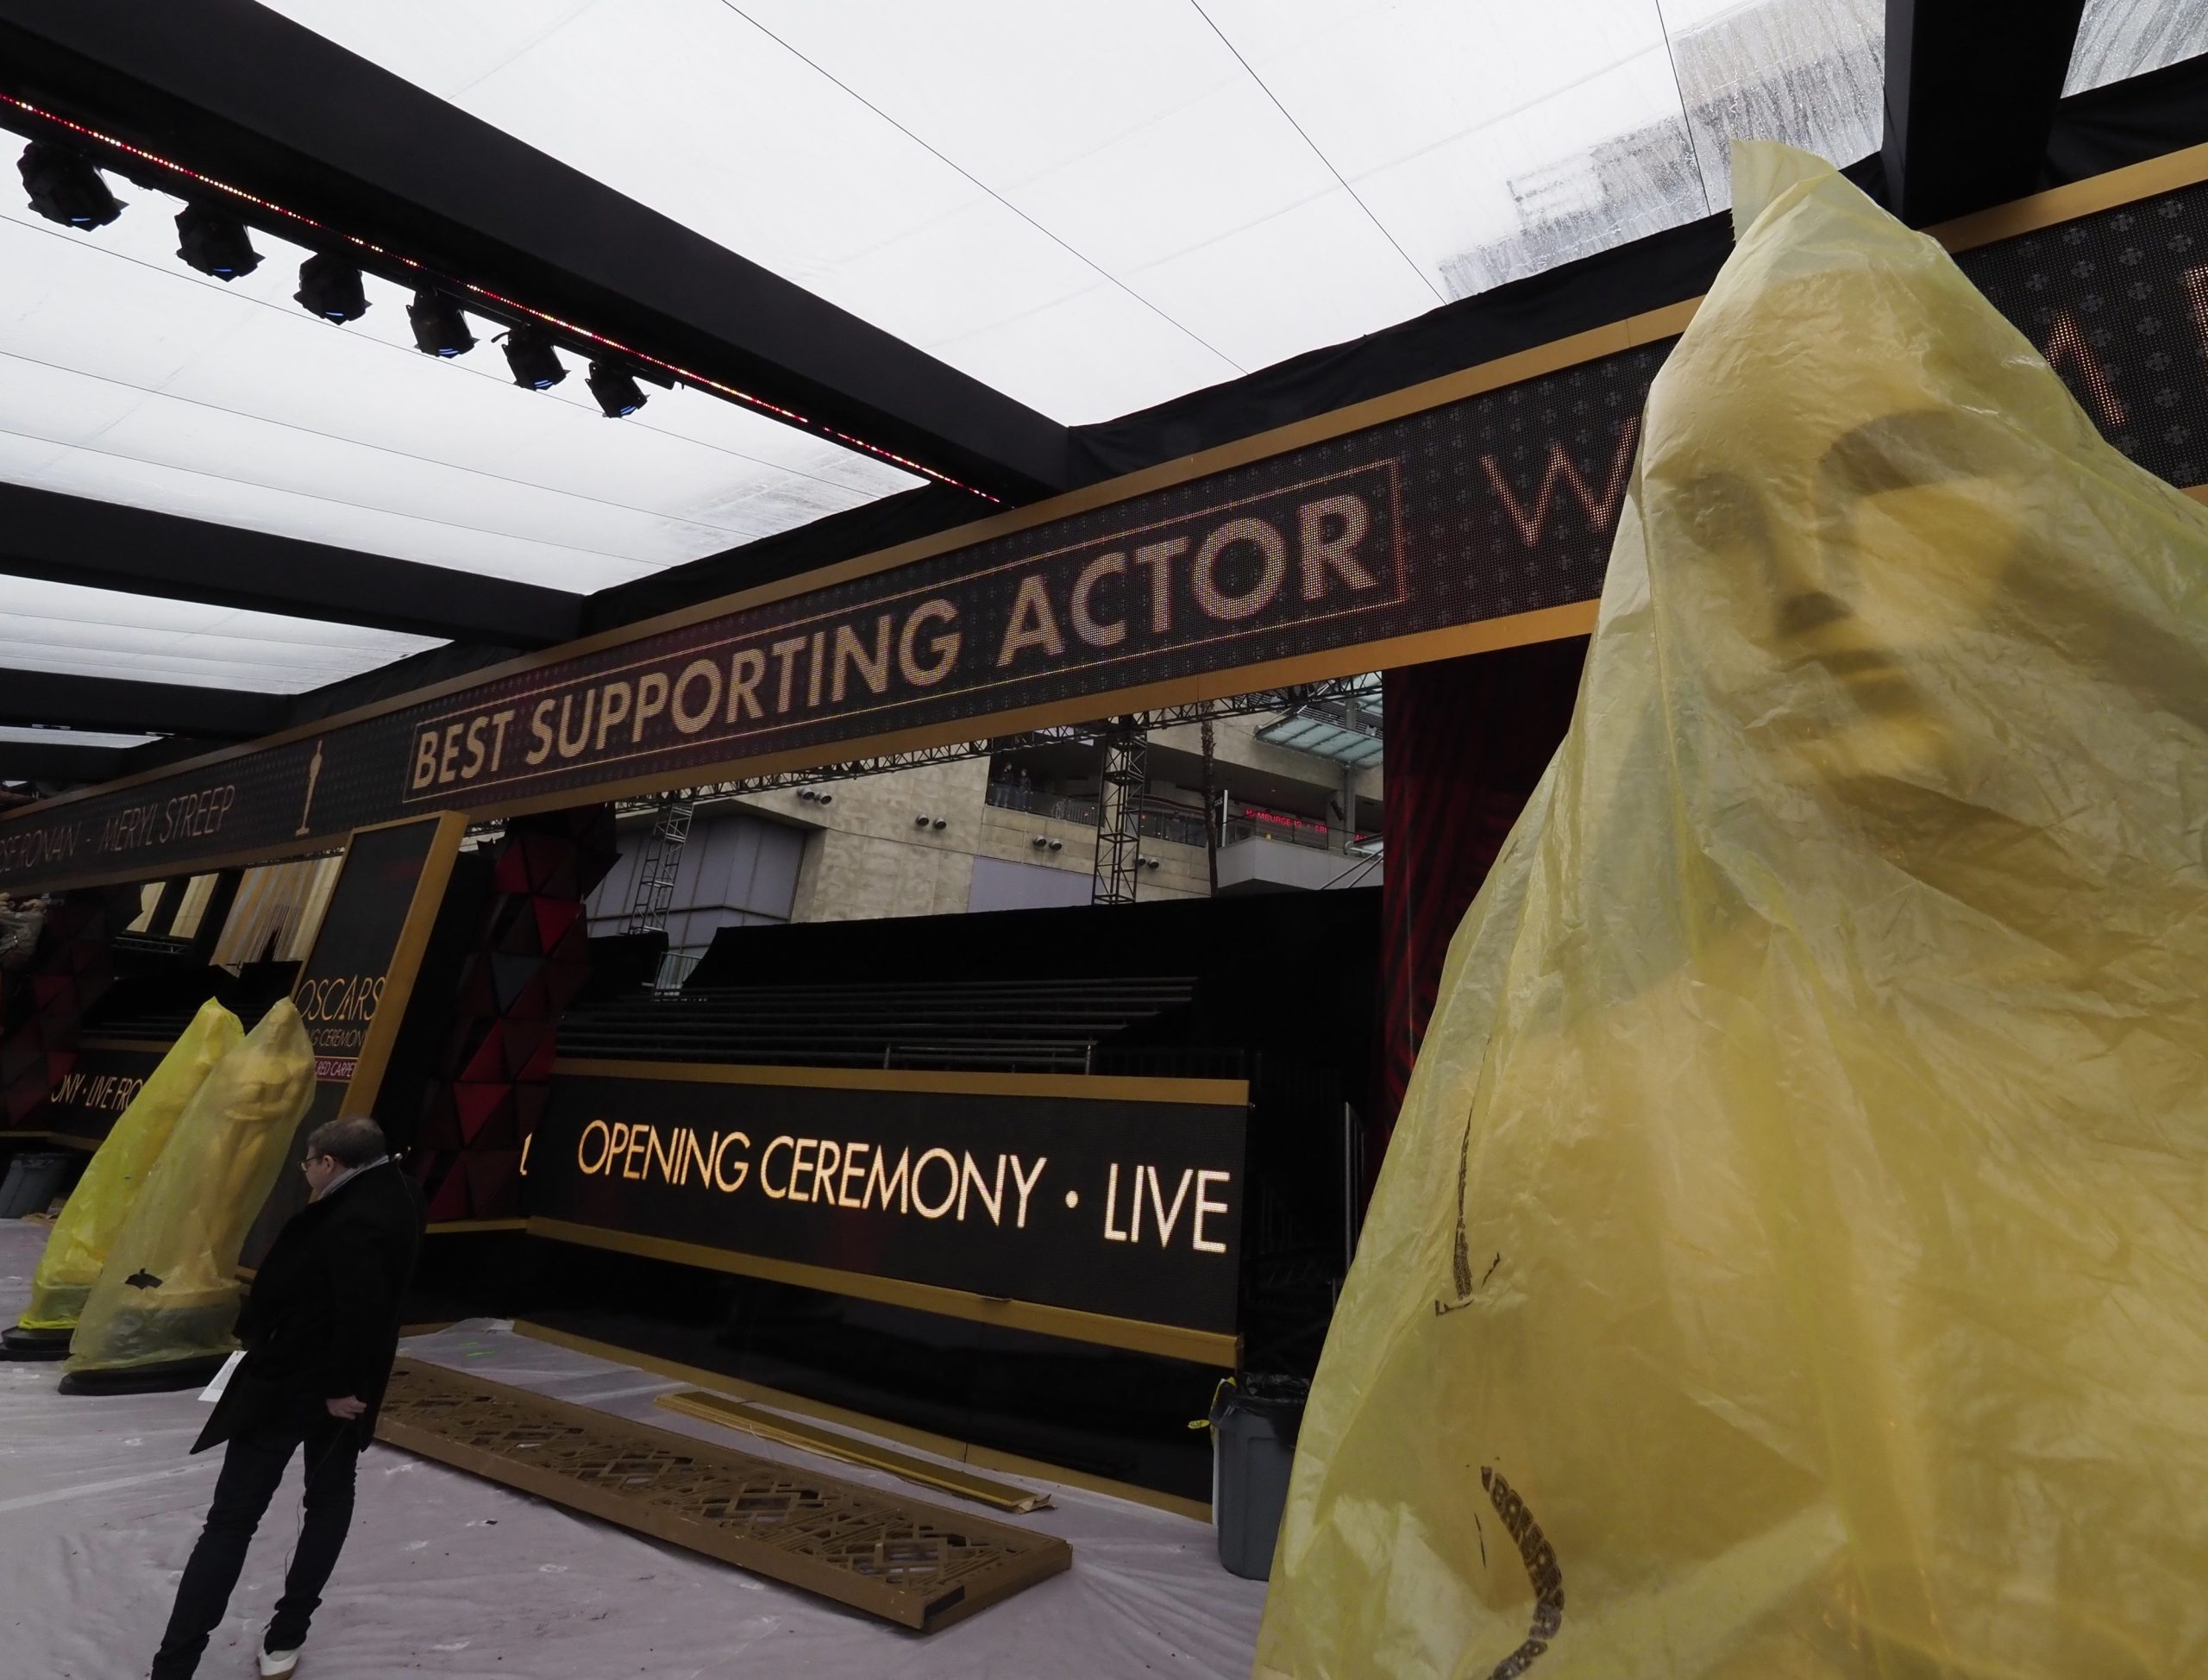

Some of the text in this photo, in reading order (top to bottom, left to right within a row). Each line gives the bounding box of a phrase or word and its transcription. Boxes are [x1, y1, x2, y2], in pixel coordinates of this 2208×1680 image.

[412, 492, 1380, 790] BEST SUPPORTING ACTOR
[97, 802, 158, 856] MERYL
[159, 783, 236, 844] STREEP
[294, 974, 386, 1021] OSCARS
[319, 1028, 367, 1048] CEREMON
[85, 1075, 117, 1109] LIVE
[110, 1077, 143, 1111] FRO
[577, 1119, 750, 1194] OPENING
[760, 1134, 1048, 1228] CEREMONY
[1104, 1162, 1231, 1254] LIVE
